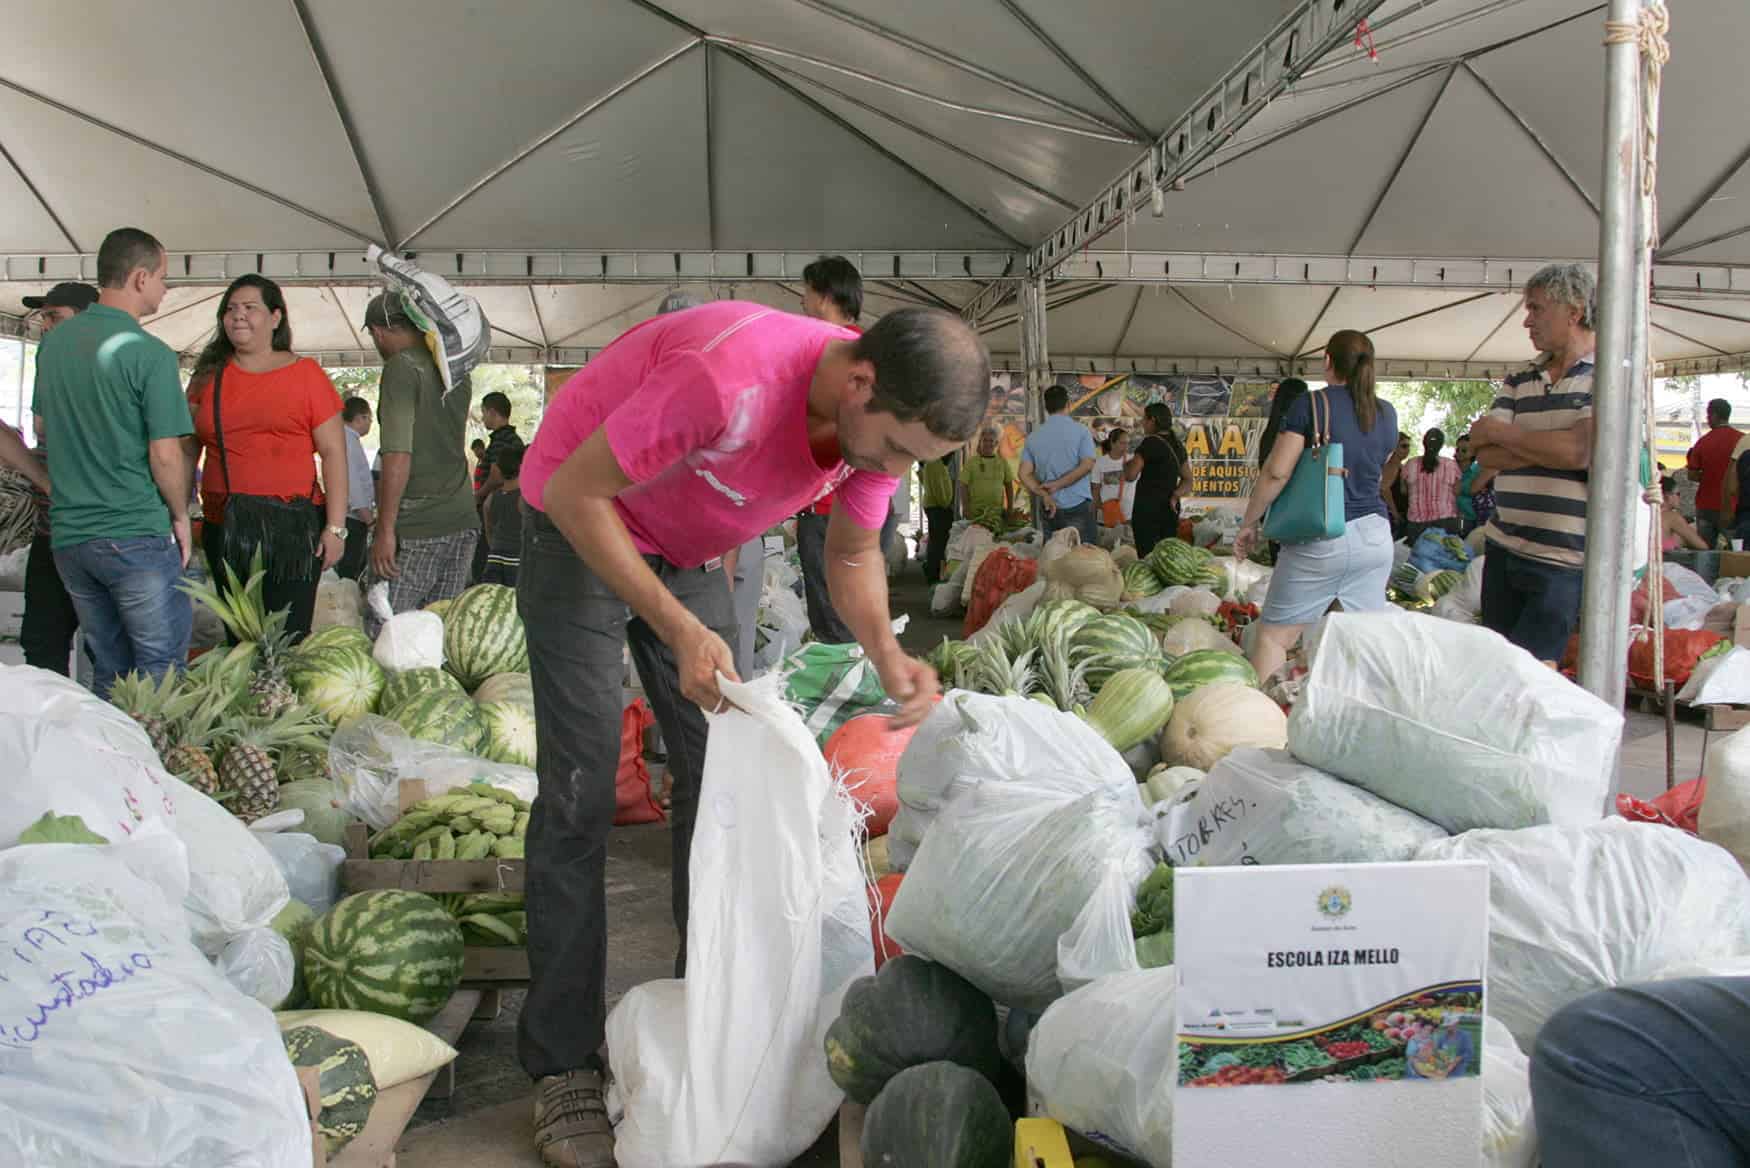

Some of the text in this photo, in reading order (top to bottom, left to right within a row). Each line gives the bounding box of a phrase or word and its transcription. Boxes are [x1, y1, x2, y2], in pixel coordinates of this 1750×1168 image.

[1192, 465, 1209, 477] DE
[1192, 480, 1239, 493] MENTOS
[1267, 948, 1400, 967] ESCOLA IZA MELLO
